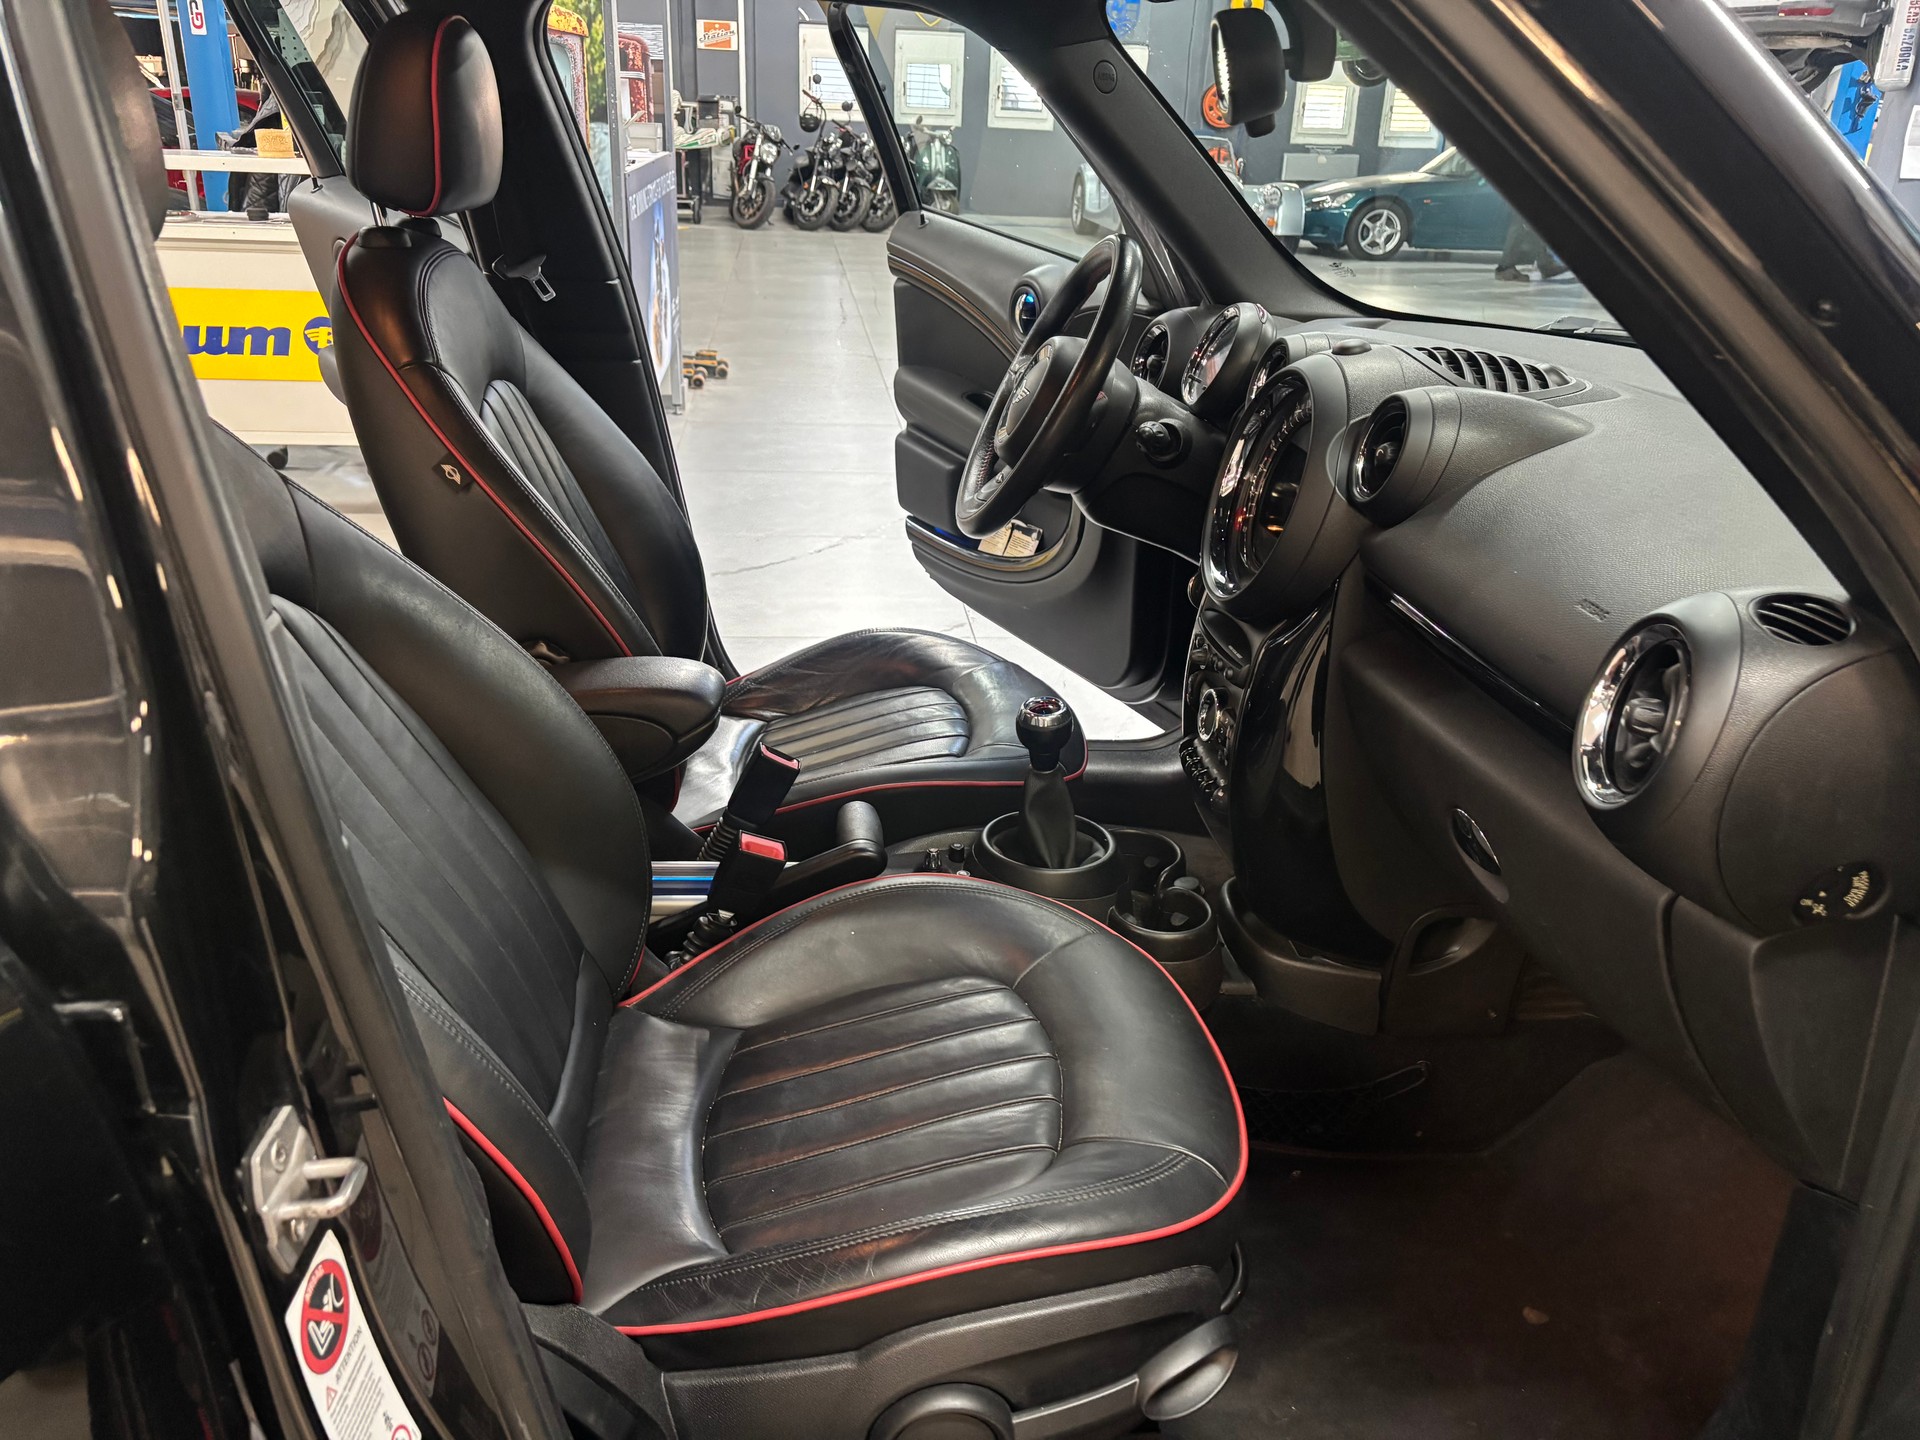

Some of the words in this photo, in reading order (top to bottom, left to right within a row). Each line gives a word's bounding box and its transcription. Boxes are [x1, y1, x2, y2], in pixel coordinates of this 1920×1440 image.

[699, 29, 736, 43] Station
[1896, 28, 1915, 71] BAZOOKA
[334, 1325, 364, 1387] ATTENTION
